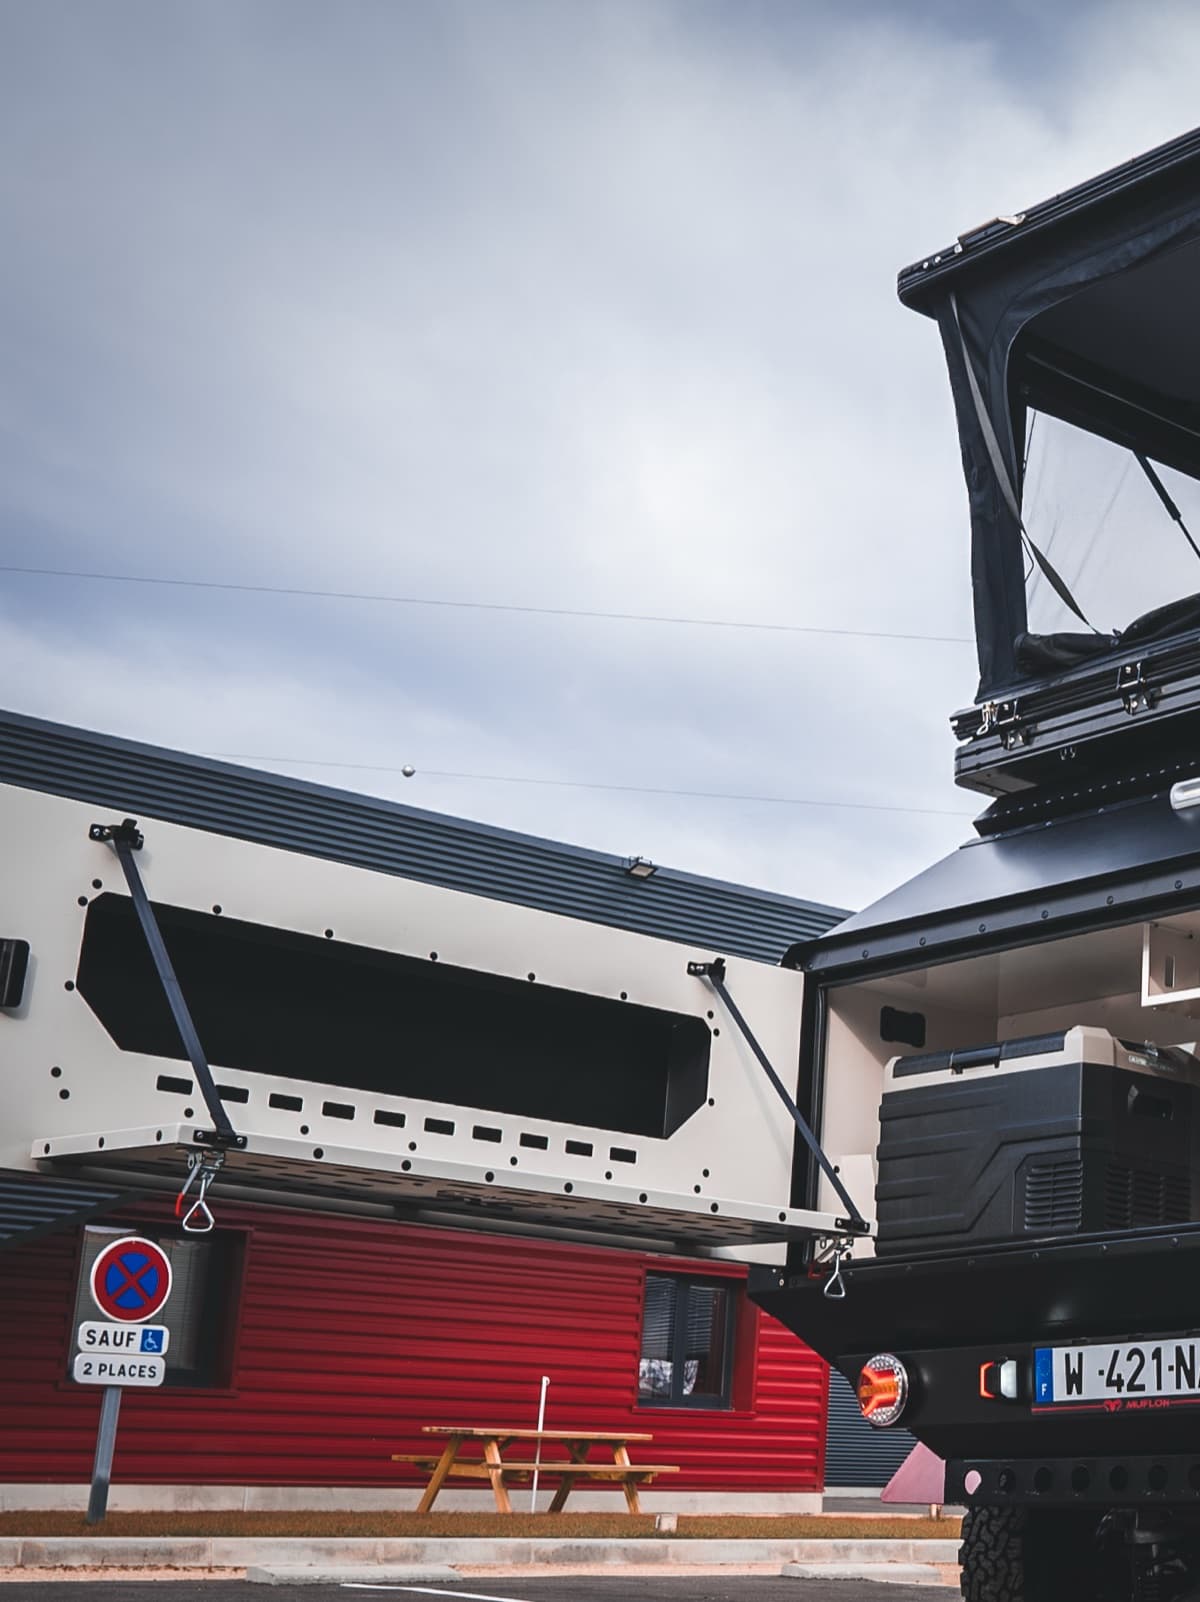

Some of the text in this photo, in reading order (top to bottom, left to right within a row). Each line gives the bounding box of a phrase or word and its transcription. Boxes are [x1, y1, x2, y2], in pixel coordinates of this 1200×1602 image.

[85, 1329, 137, 1347] SAUF
[83, 1362, 157, 1379] 2 PLACES
[1041, 1383, 1048, 1397] F
